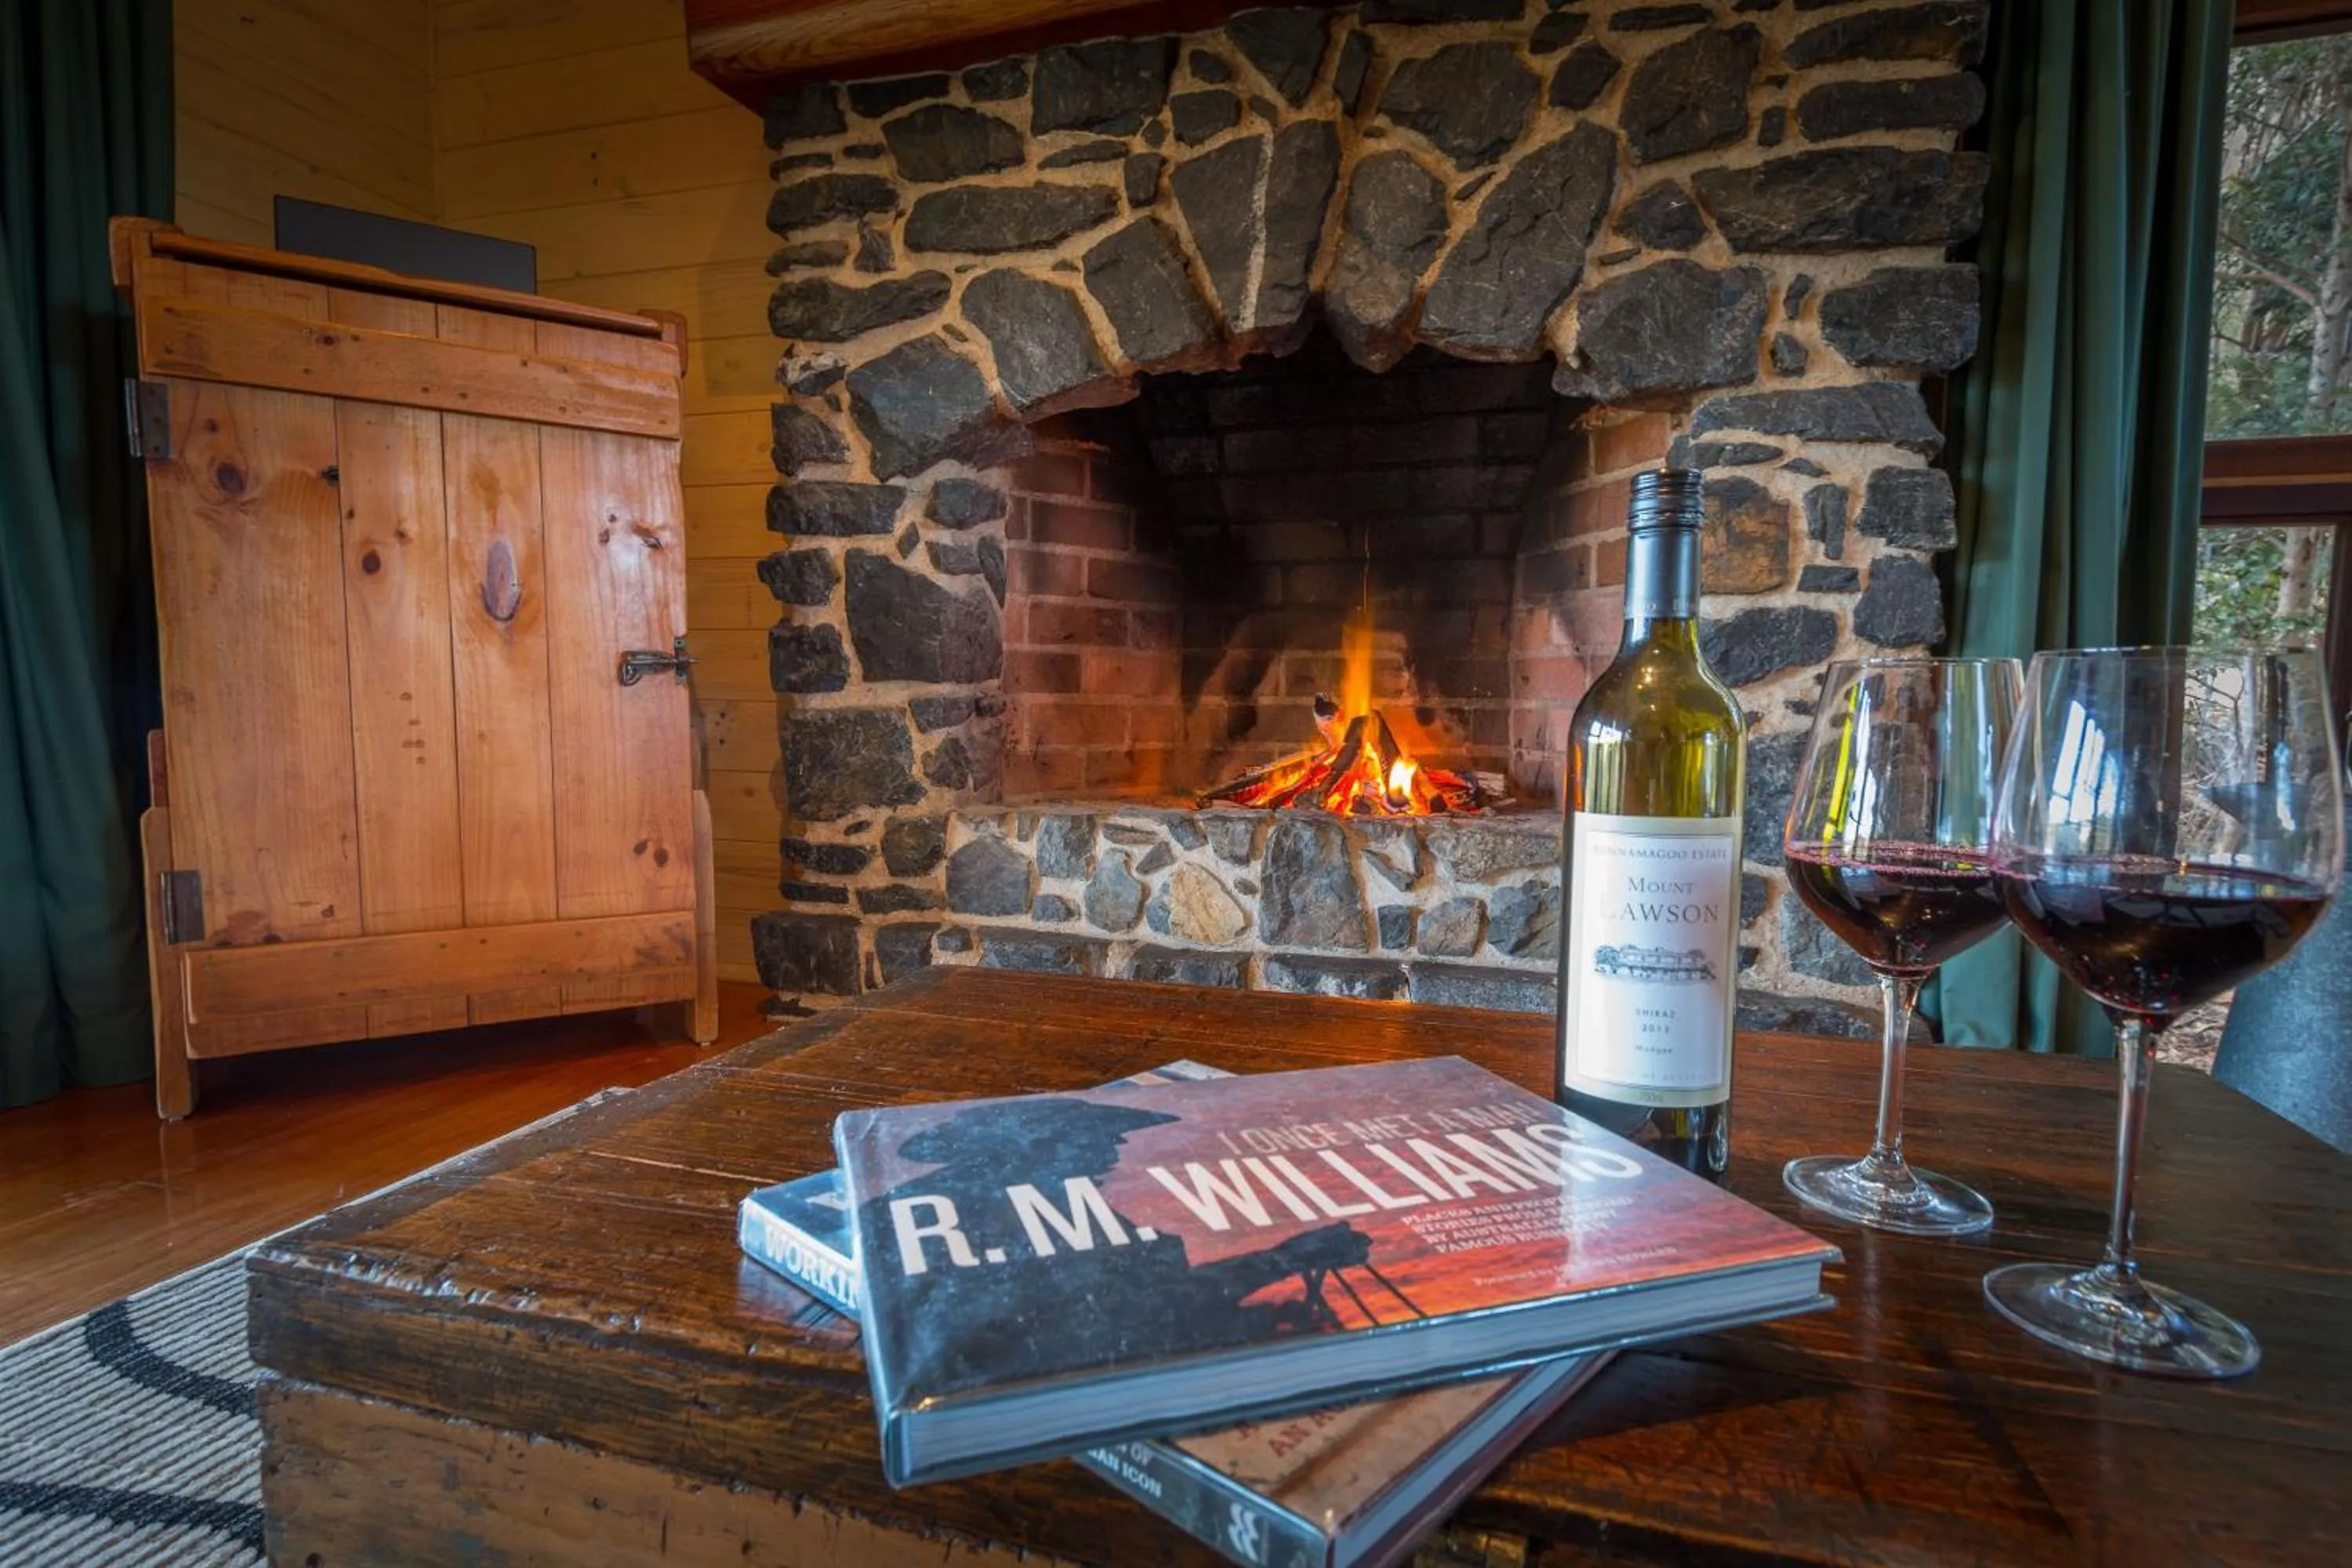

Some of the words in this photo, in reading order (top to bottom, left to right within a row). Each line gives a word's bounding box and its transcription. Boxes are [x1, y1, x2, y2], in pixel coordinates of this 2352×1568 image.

[1594, 844, 1688, 860] NNAMAGOO
[1628, 876, 1696, 895] MOUNT
[1602, 898, 1719, 924] AWSON
[1635, 1007, 1676, 1019] SHIRAZ
[1217, 1131, 1241, 1155] I
[1243, 1122, 1352, 1154] ONCE
[1344, 1113, 1429, 1143] MET
[1428, 1110, 1466, 1131] A
[889, 1175, 1159, 1276] R.M.
[1146, 1123, 1644, 1232] WILLIAMS
[1122, 1461, 1163, 1499] ICON
